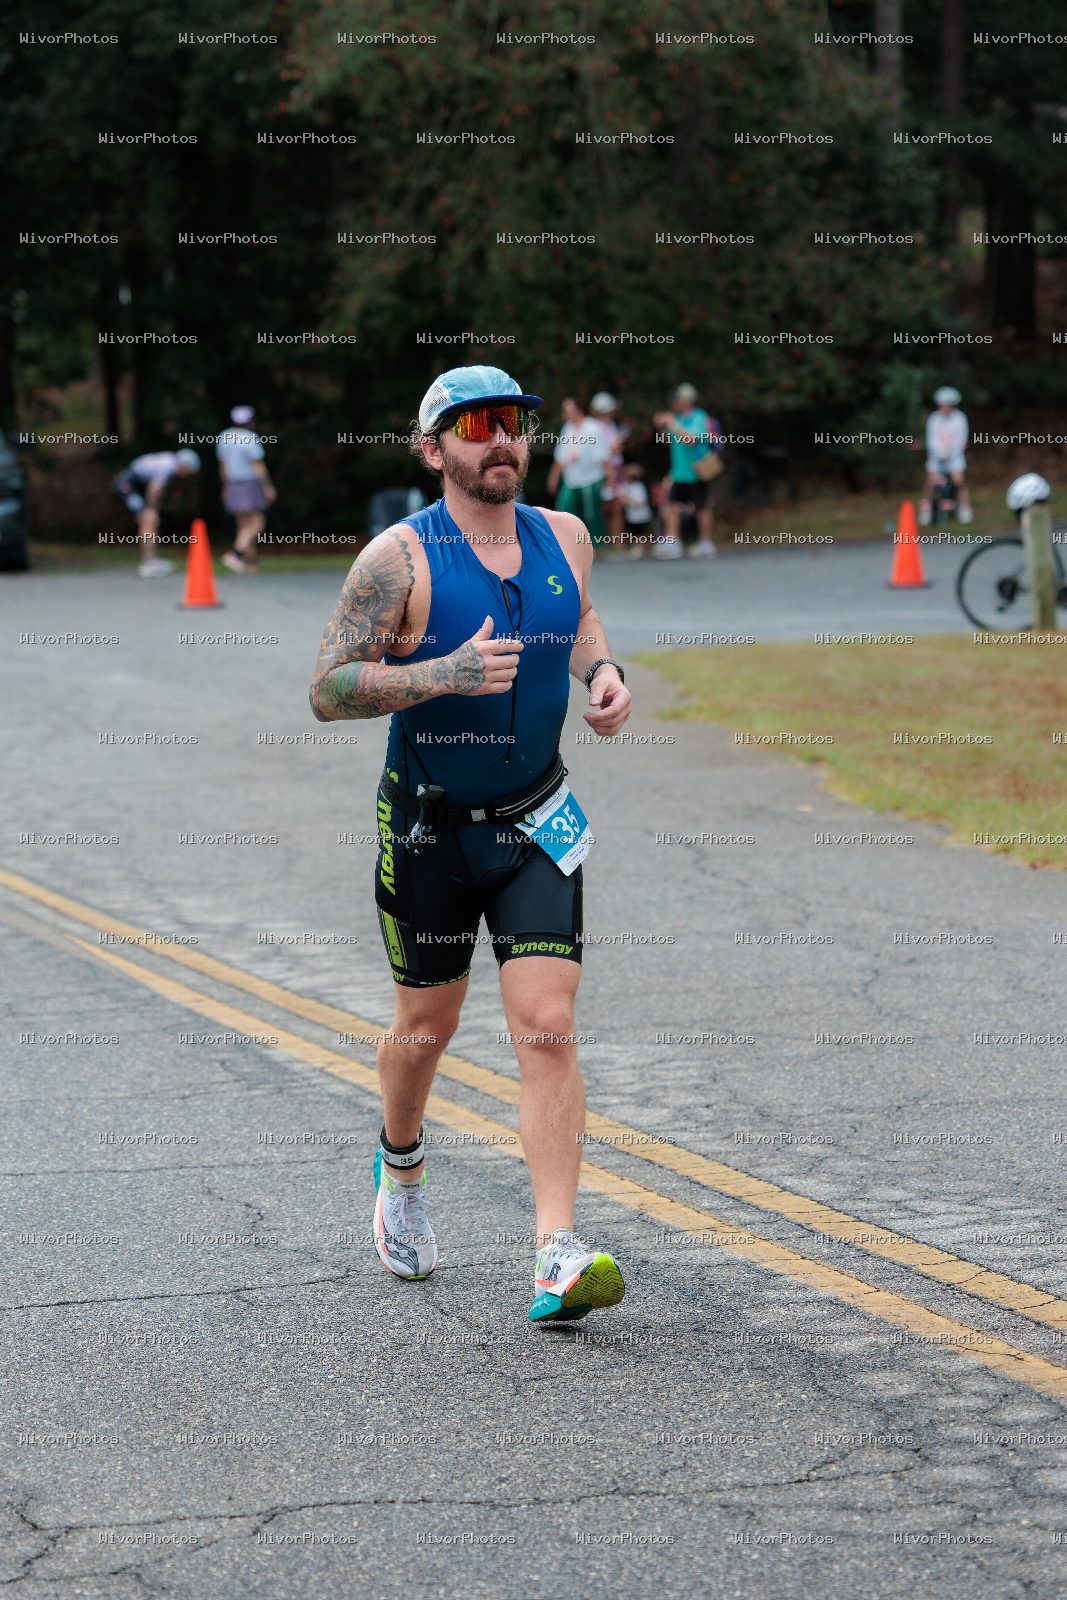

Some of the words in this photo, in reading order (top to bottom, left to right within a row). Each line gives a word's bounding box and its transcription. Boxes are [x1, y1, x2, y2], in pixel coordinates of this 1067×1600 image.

[551, 804, 580, 844] 35
[511, 941, 574, 955] synergy
[400, 1156, 414, 1165] 35
